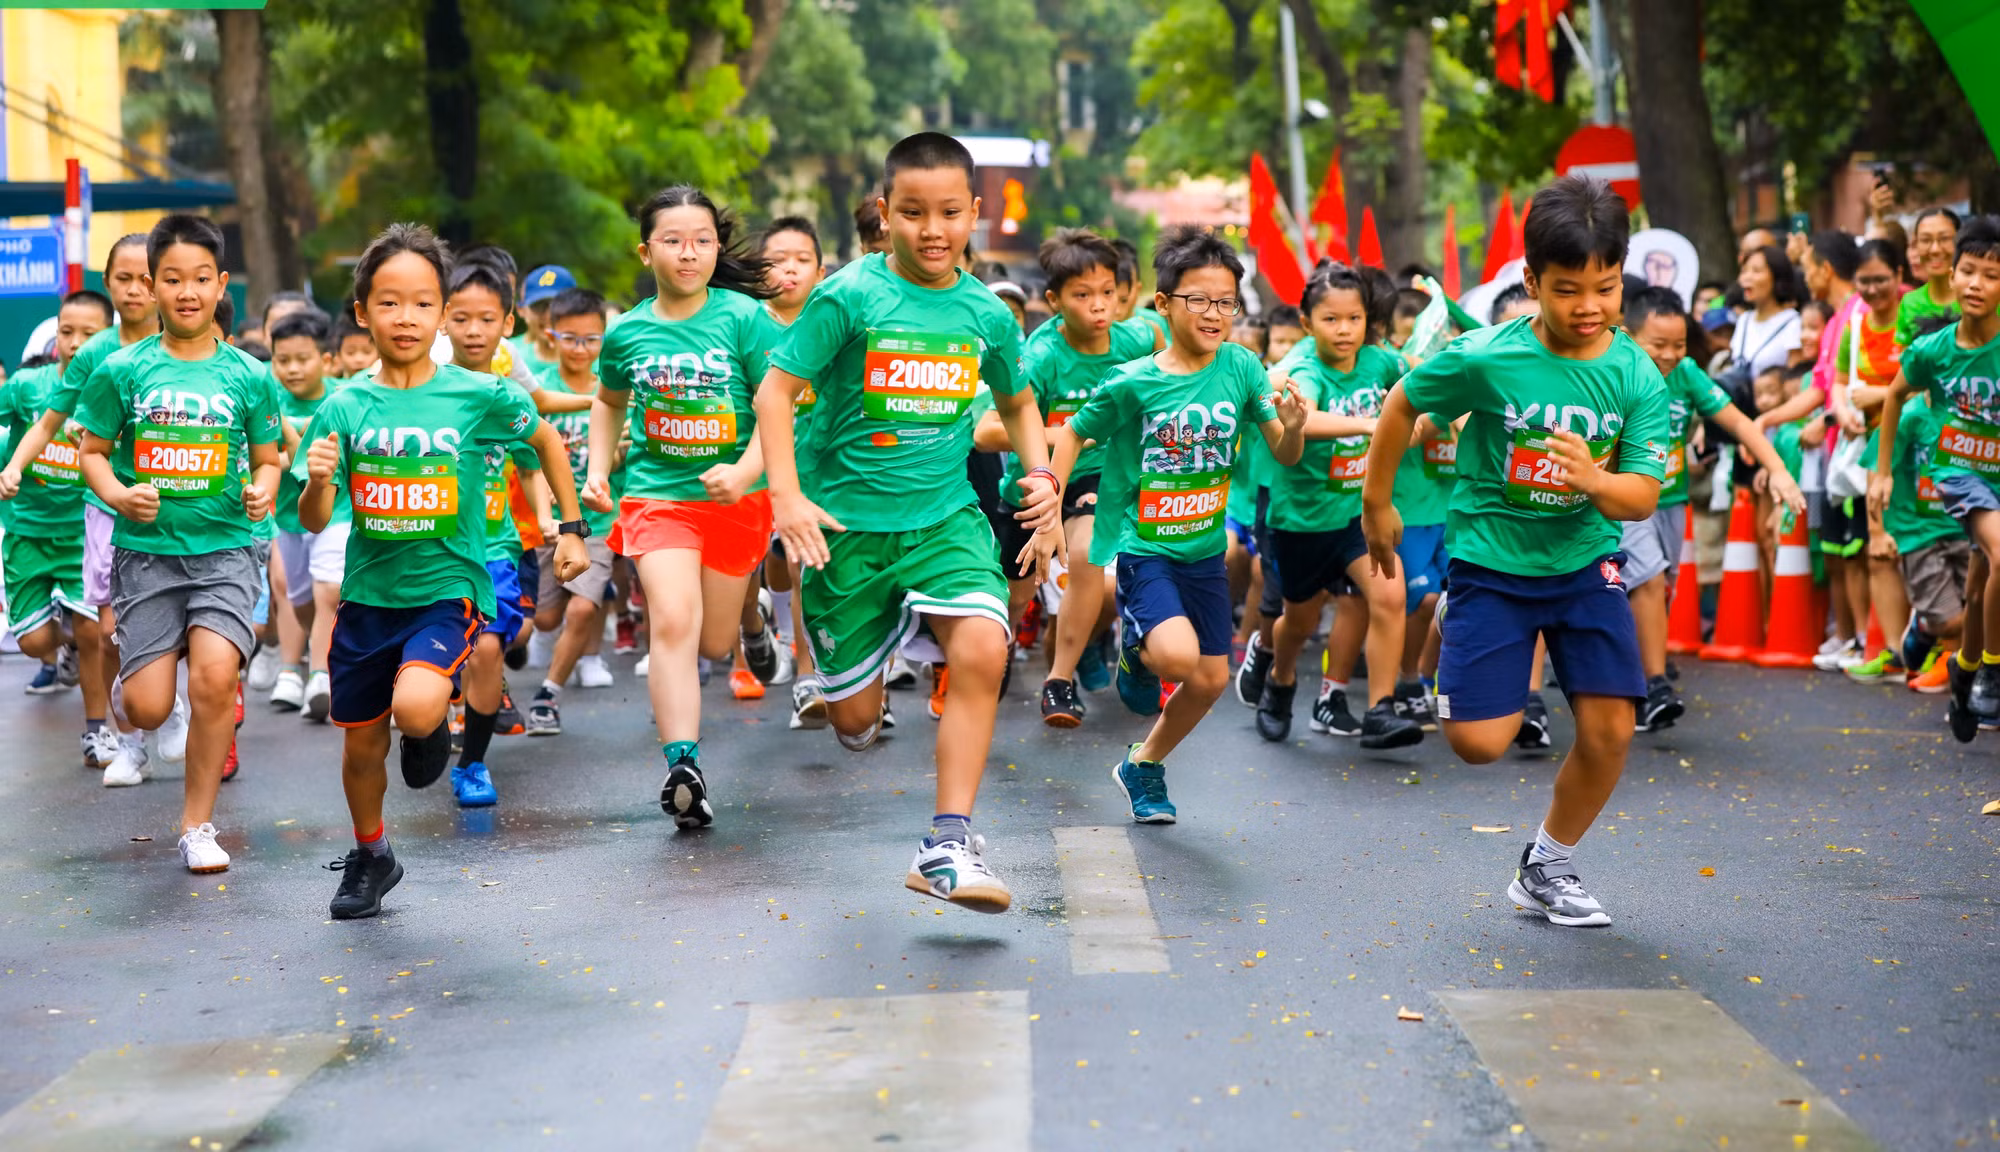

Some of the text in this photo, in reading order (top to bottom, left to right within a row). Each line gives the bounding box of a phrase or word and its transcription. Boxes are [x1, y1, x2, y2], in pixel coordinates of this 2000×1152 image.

[631, 348, 732, 386] KIDS
[888, 360, 962, 391] 20062
[133, 389, 235, 427] KIDS
[660, 416, 720, 439] 20069
[1140, 401, 1237, 445] KIDS
[151, 447, 214, 471] 20057
[365, 482, 438, 510] 20183
[1158, 490, 1220, 518] 20205
